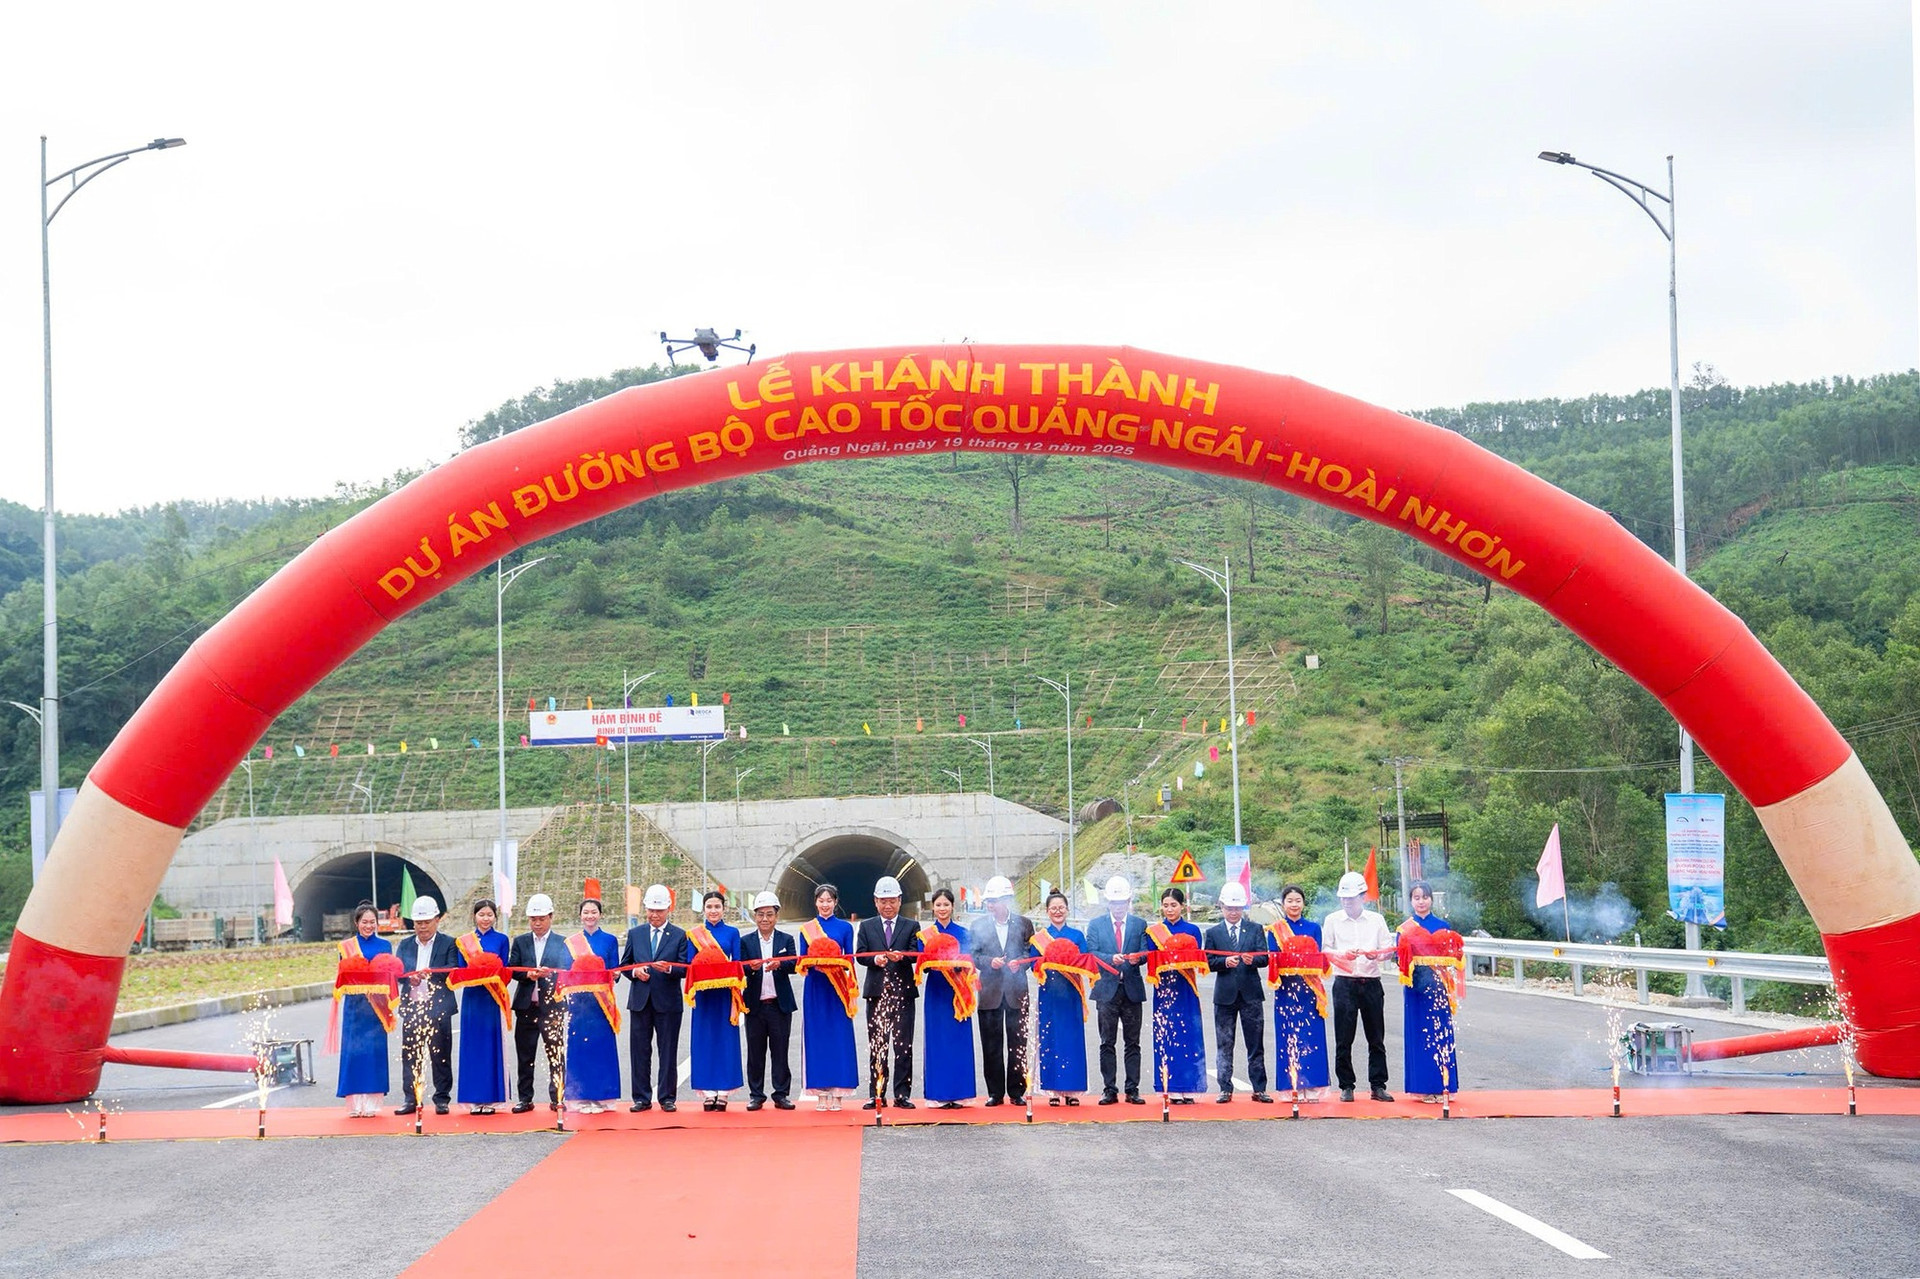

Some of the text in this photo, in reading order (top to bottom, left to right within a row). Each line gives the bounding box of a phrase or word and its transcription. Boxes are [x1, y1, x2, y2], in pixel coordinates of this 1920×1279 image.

[727, 353, 1220, 417] LỄ KHÁNH THÀNH
[783, 444, 840, 461] Quảng
[893, 439, 937, 451] ngày
[944, 437, 963, 447] 19
[968, 438, 1019, 450] tháng
[1024, 442, 1044, 451] 12
[1049, 443, 1086, 452] năm
[1092, 444, 1136, 456] 2025
[378, 537, 442, 600] DỰ
[448, 512, 508, 558] ÁN
[511, 441, 680, 518] ĐƯỜNG
[688, 415, 754, 464] BỘ
[765, 402, 861, 442] CAO
[870, 391, 963, 433] TỐC
[971, 396, 1140, 442] QUẢNG
[1401, 495, 1527, 580] NHƠN
[629, 726, 658, 734] TUNNEL
